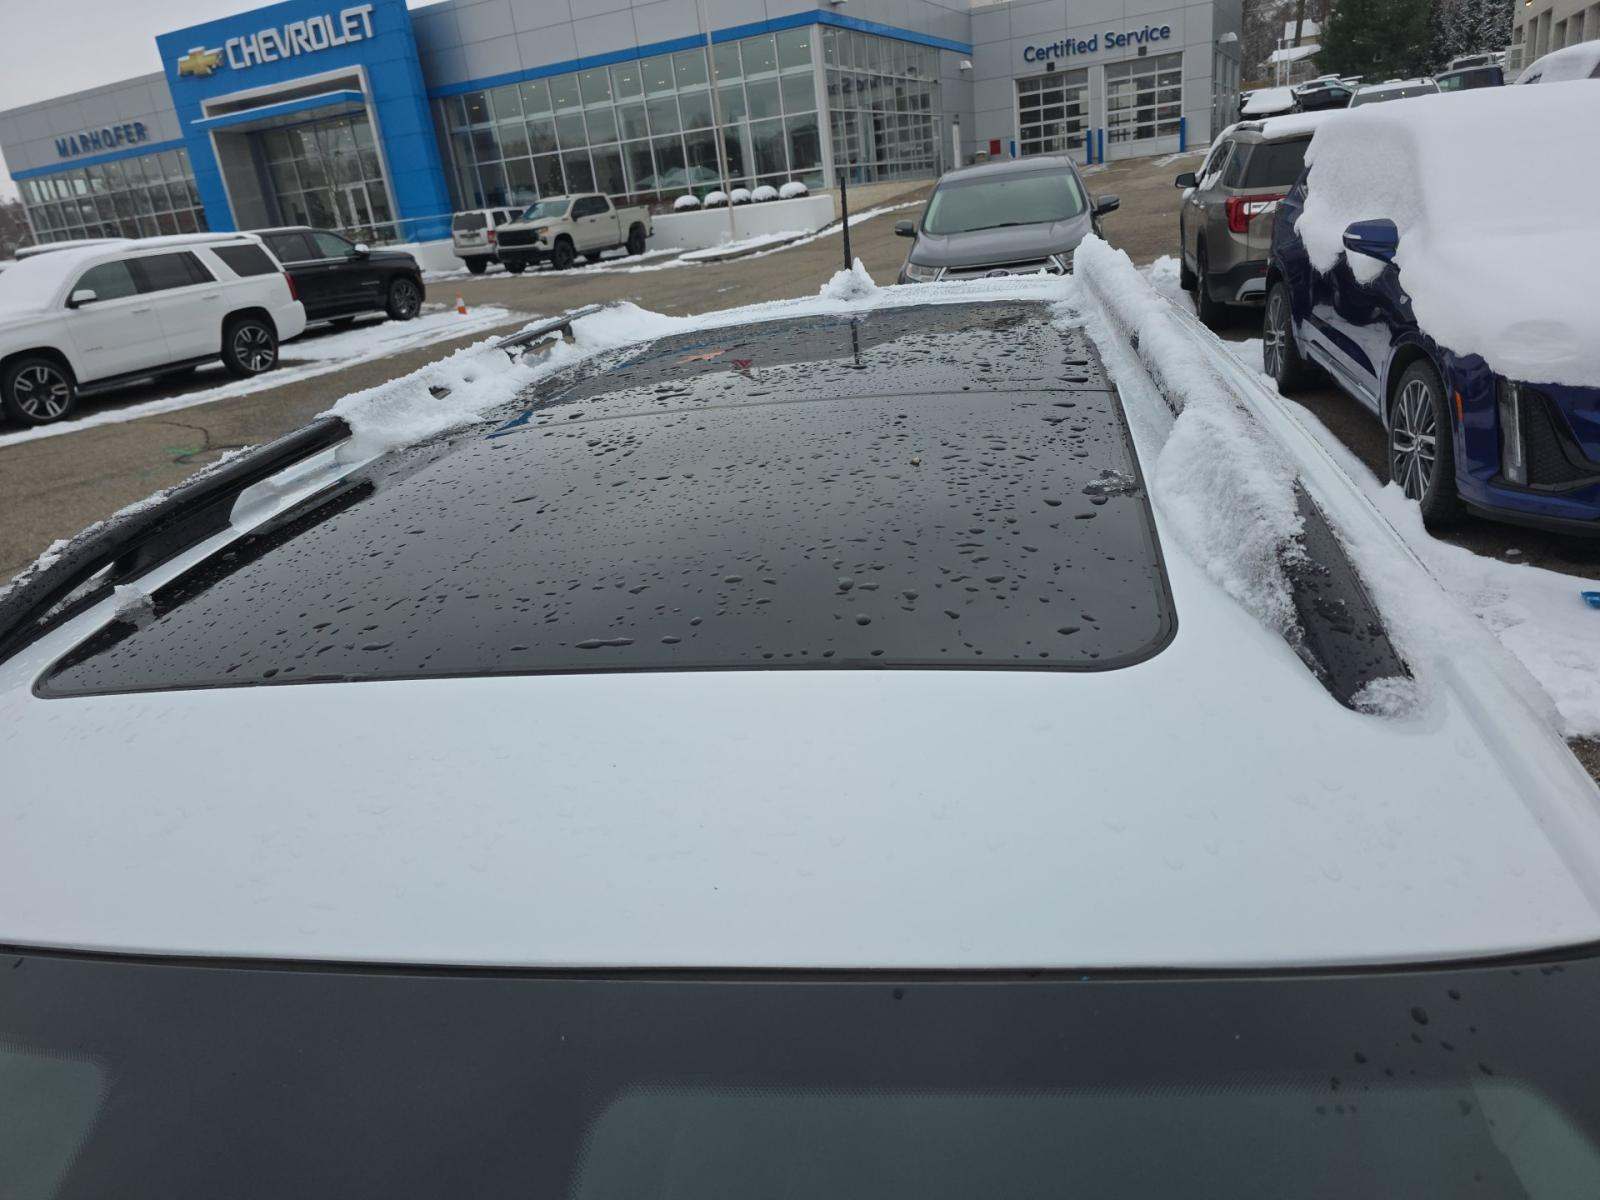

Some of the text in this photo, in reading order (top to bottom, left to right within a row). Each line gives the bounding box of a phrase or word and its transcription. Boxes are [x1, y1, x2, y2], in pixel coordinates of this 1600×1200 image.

[225, 4, 373, 70] CHEVROLET
[1024, 25, 1171, 62] Certified Service
[55, 122, 147, 157] MARHOFER
